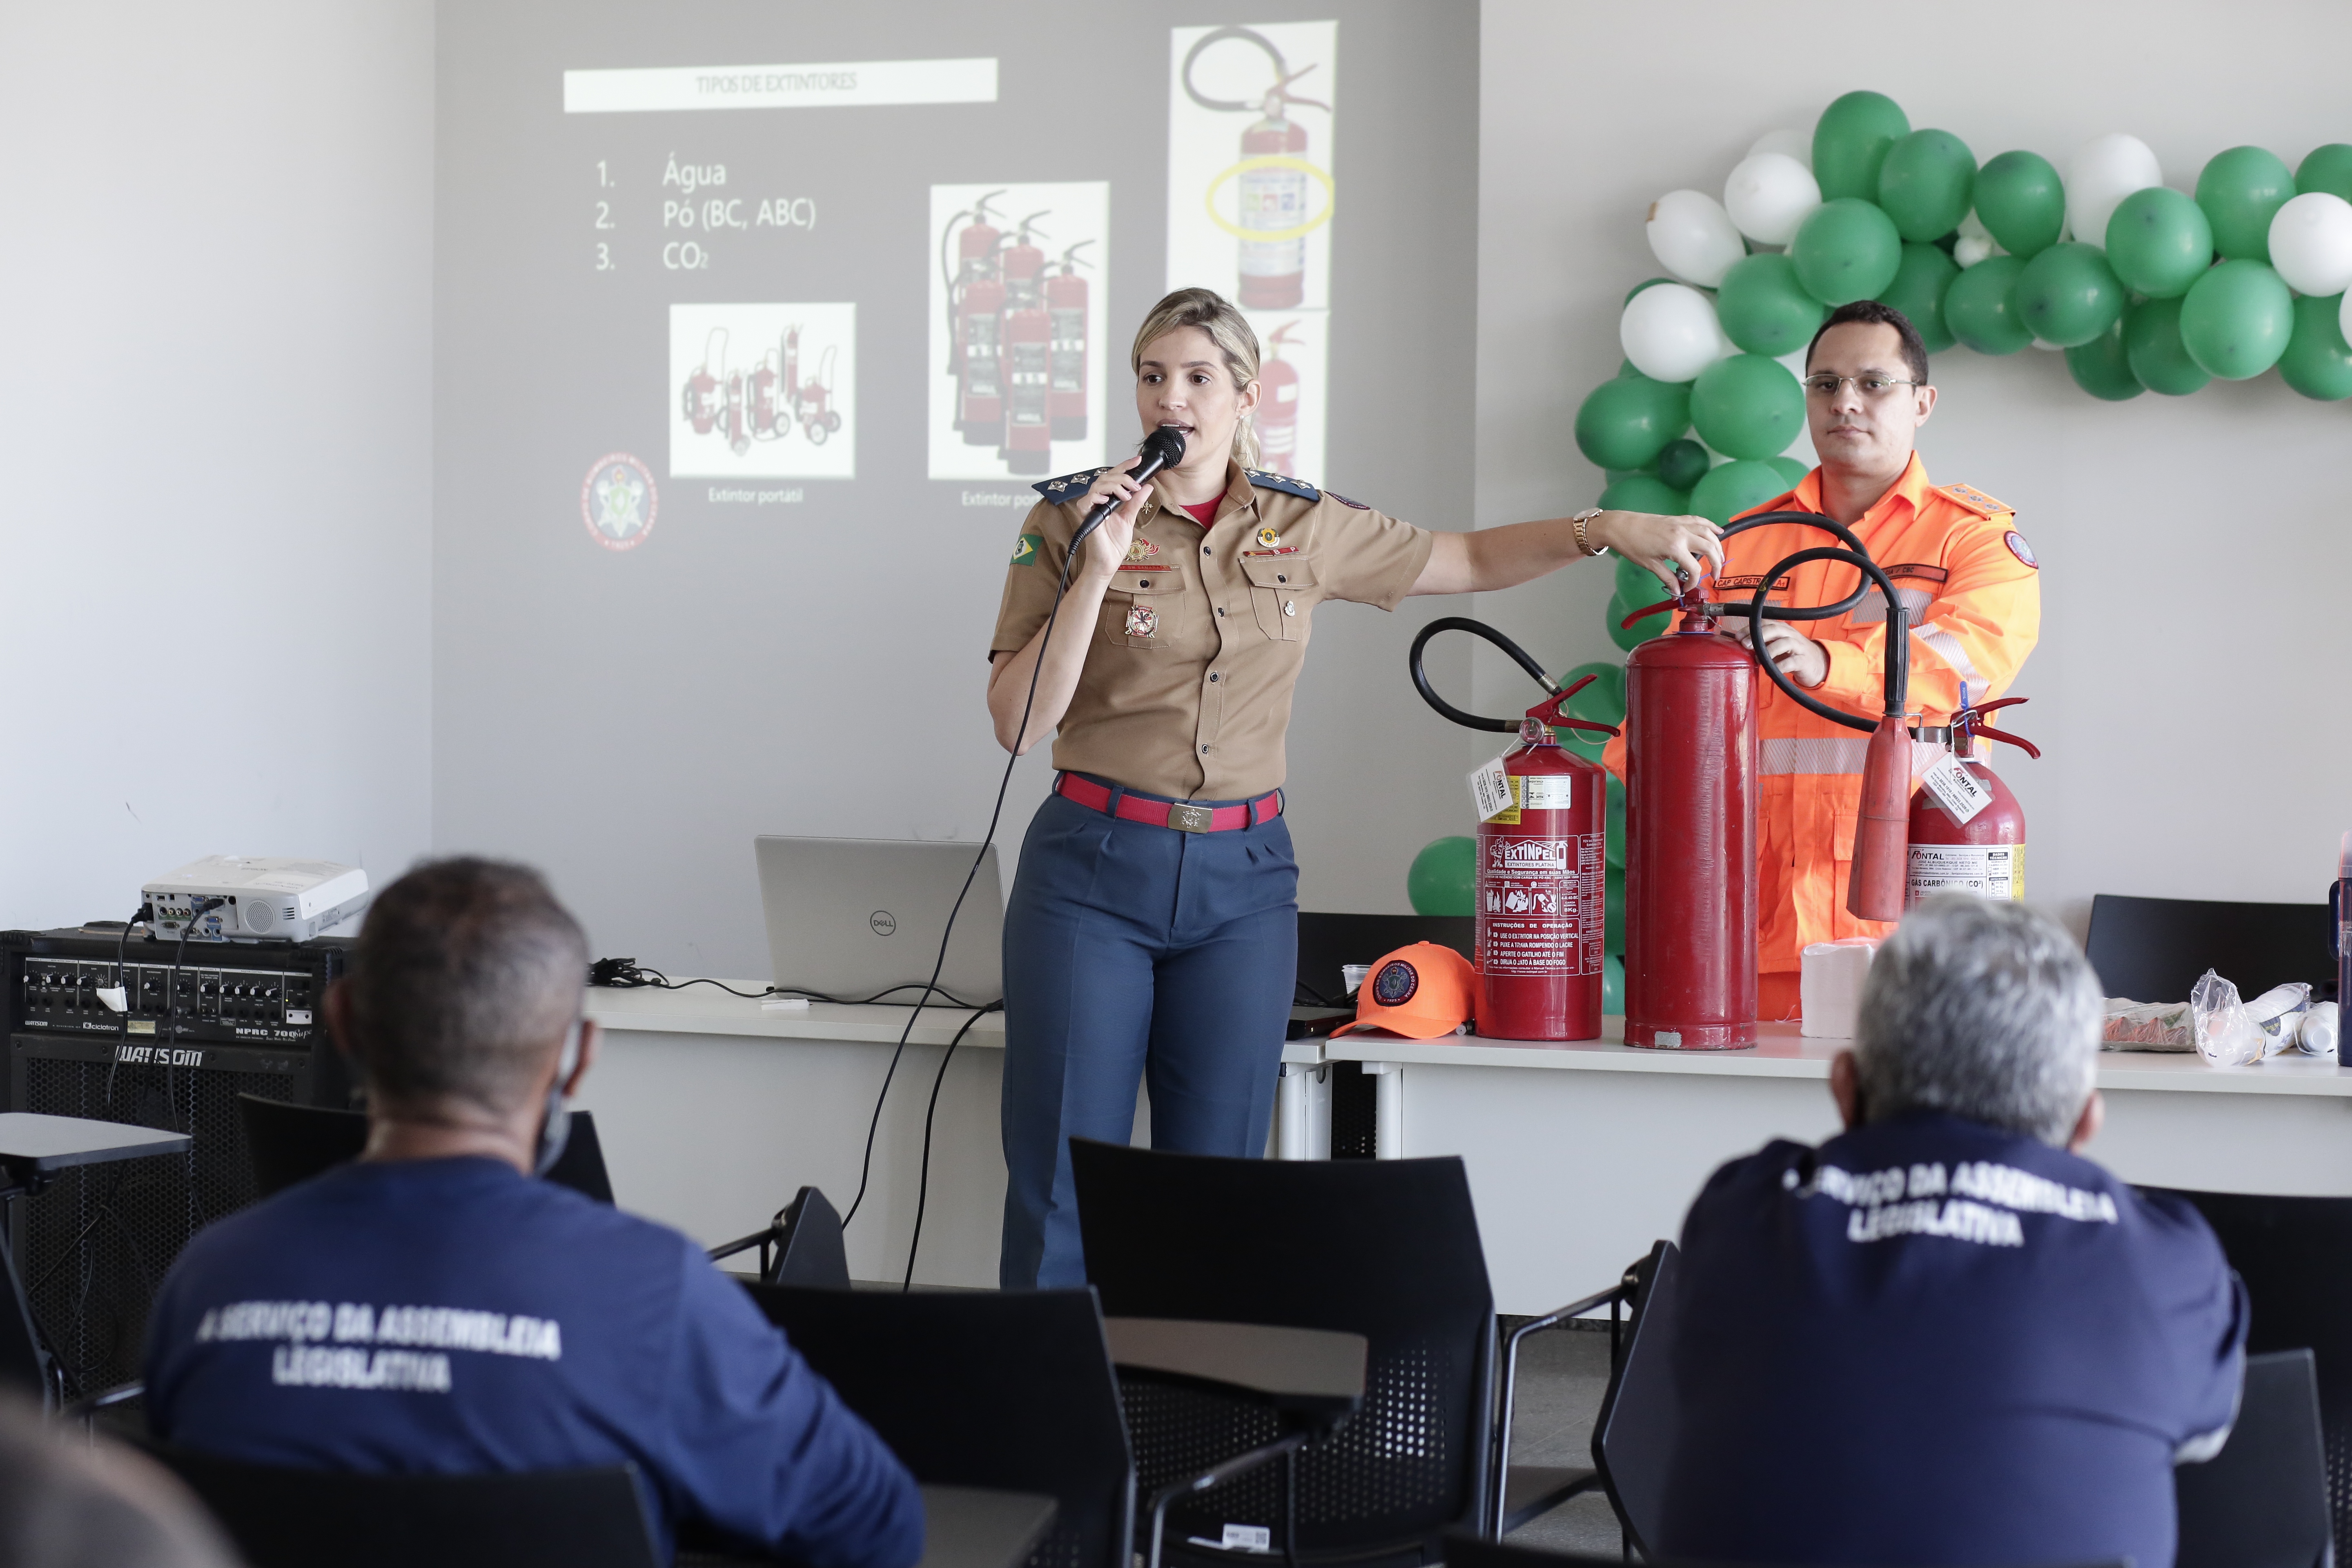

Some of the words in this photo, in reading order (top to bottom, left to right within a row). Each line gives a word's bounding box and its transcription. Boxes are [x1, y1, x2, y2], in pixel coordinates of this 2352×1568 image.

[697, 75, 738, 93] TIPOS
[742, 75, 762, 93] DE
[766, 72, 857, 92] EXTINTORES
[597, 159, 615, 187] 1.
[663, 152, 726, 193] Água
[595, 202, 615, 228] 2.
[664, 201, 694, 228] Pó
[702, 199, 748, 231] (BC,
[757, 198, 817, 230] ABC)
[596, 243, 615, 270] 3.
[709, 488, 757, 503] Extintor
[758, 488, 803, 506] portátil
[962, 491, 1011, 506] Extintor
[1013, 493, 1045, 509] port
[1494, 771, 1506, 799] FONTAL
[1953, 767, 1978, 797] FONTAL
[1505, 844, 1555, 860] EXTINPEL
[1911, 851, 1944, 860] FONTAL
[1911, 878, 1921, 886] GÁS
[1540, 932, 1559, 940] POSIÇÃO
[1400, 964, 1413, 976] MILITAR
[333, 1302, 374, 1343] DA
